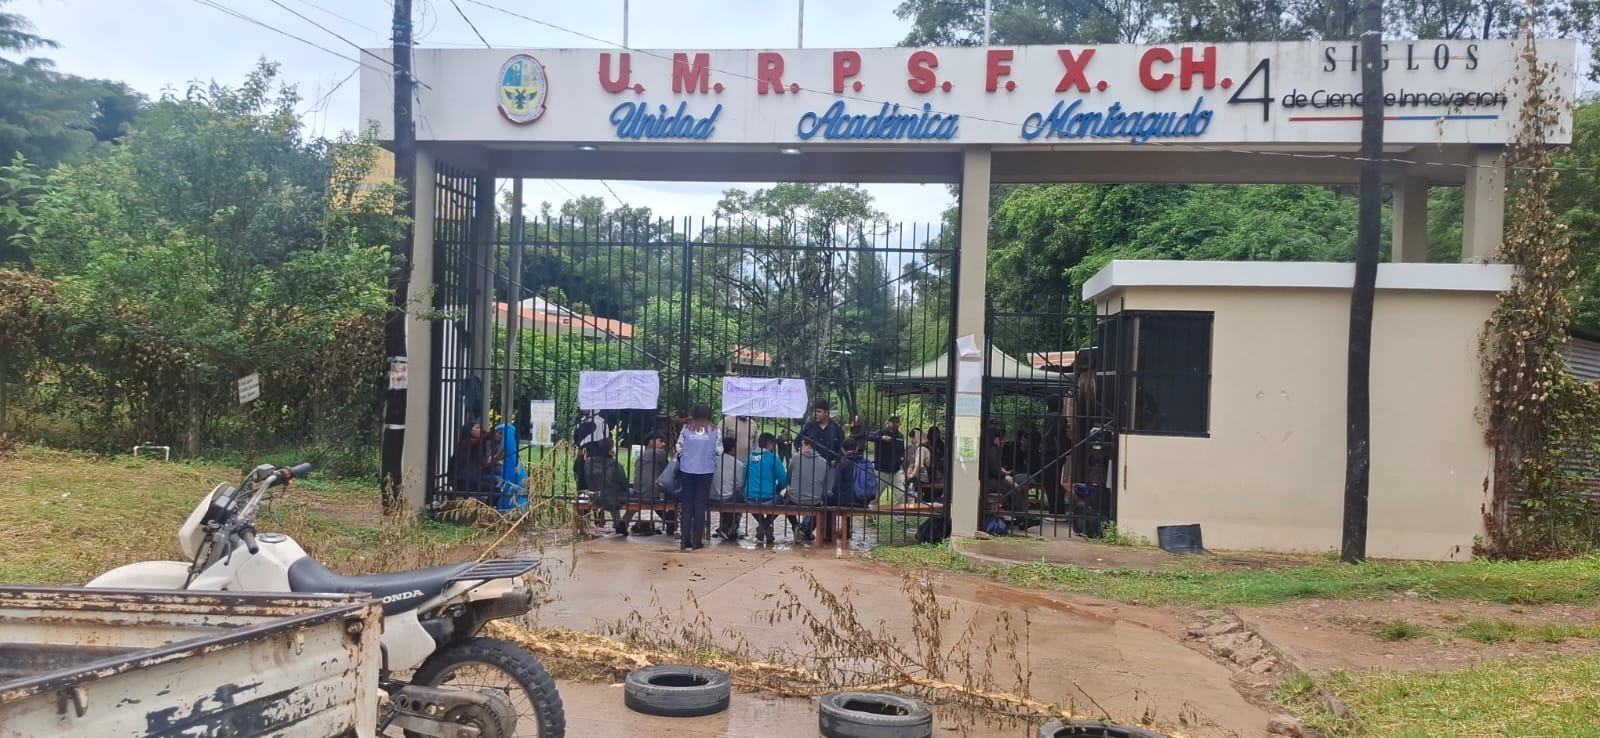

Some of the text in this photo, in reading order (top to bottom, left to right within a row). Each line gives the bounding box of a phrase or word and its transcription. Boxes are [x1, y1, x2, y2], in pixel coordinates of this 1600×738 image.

[598, 46, 1233, 95] U. M. R. P. S. F. X. CH.
[1227, 57, 1275, 122] 4
[609, 96, 1214, 145] Unidad Académica Monteagudo
[1282, 88, 1308, 108] de
[1311, 89, 1364, 109] Cienc
[1383, 92, 1396, 108] e
[382, 589, 425, 604] ONDA
